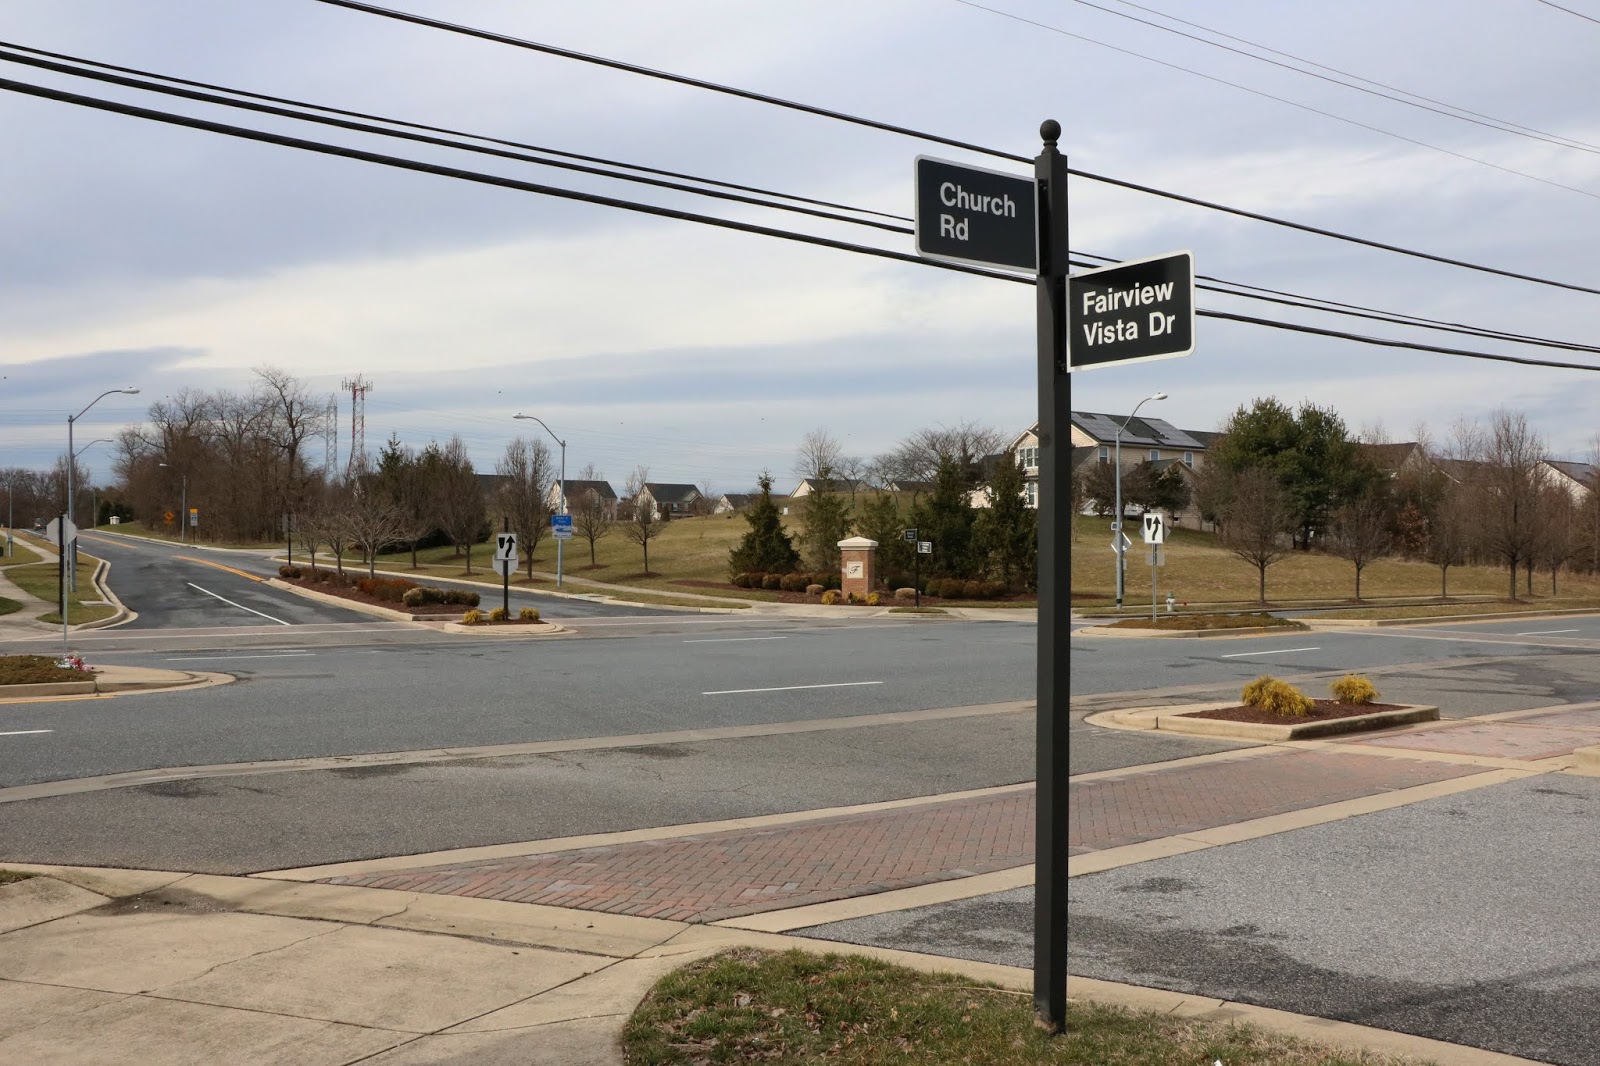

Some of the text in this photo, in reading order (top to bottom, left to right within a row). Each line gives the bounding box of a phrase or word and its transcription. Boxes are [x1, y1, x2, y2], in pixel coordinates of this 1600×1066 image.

[940, 182, 1015, 217] Church
[940, 214, 969, 241] Rd
[1083, 281, 1174, 315] Fairview
[1083, 311, 1175, 346] Vista Dr
